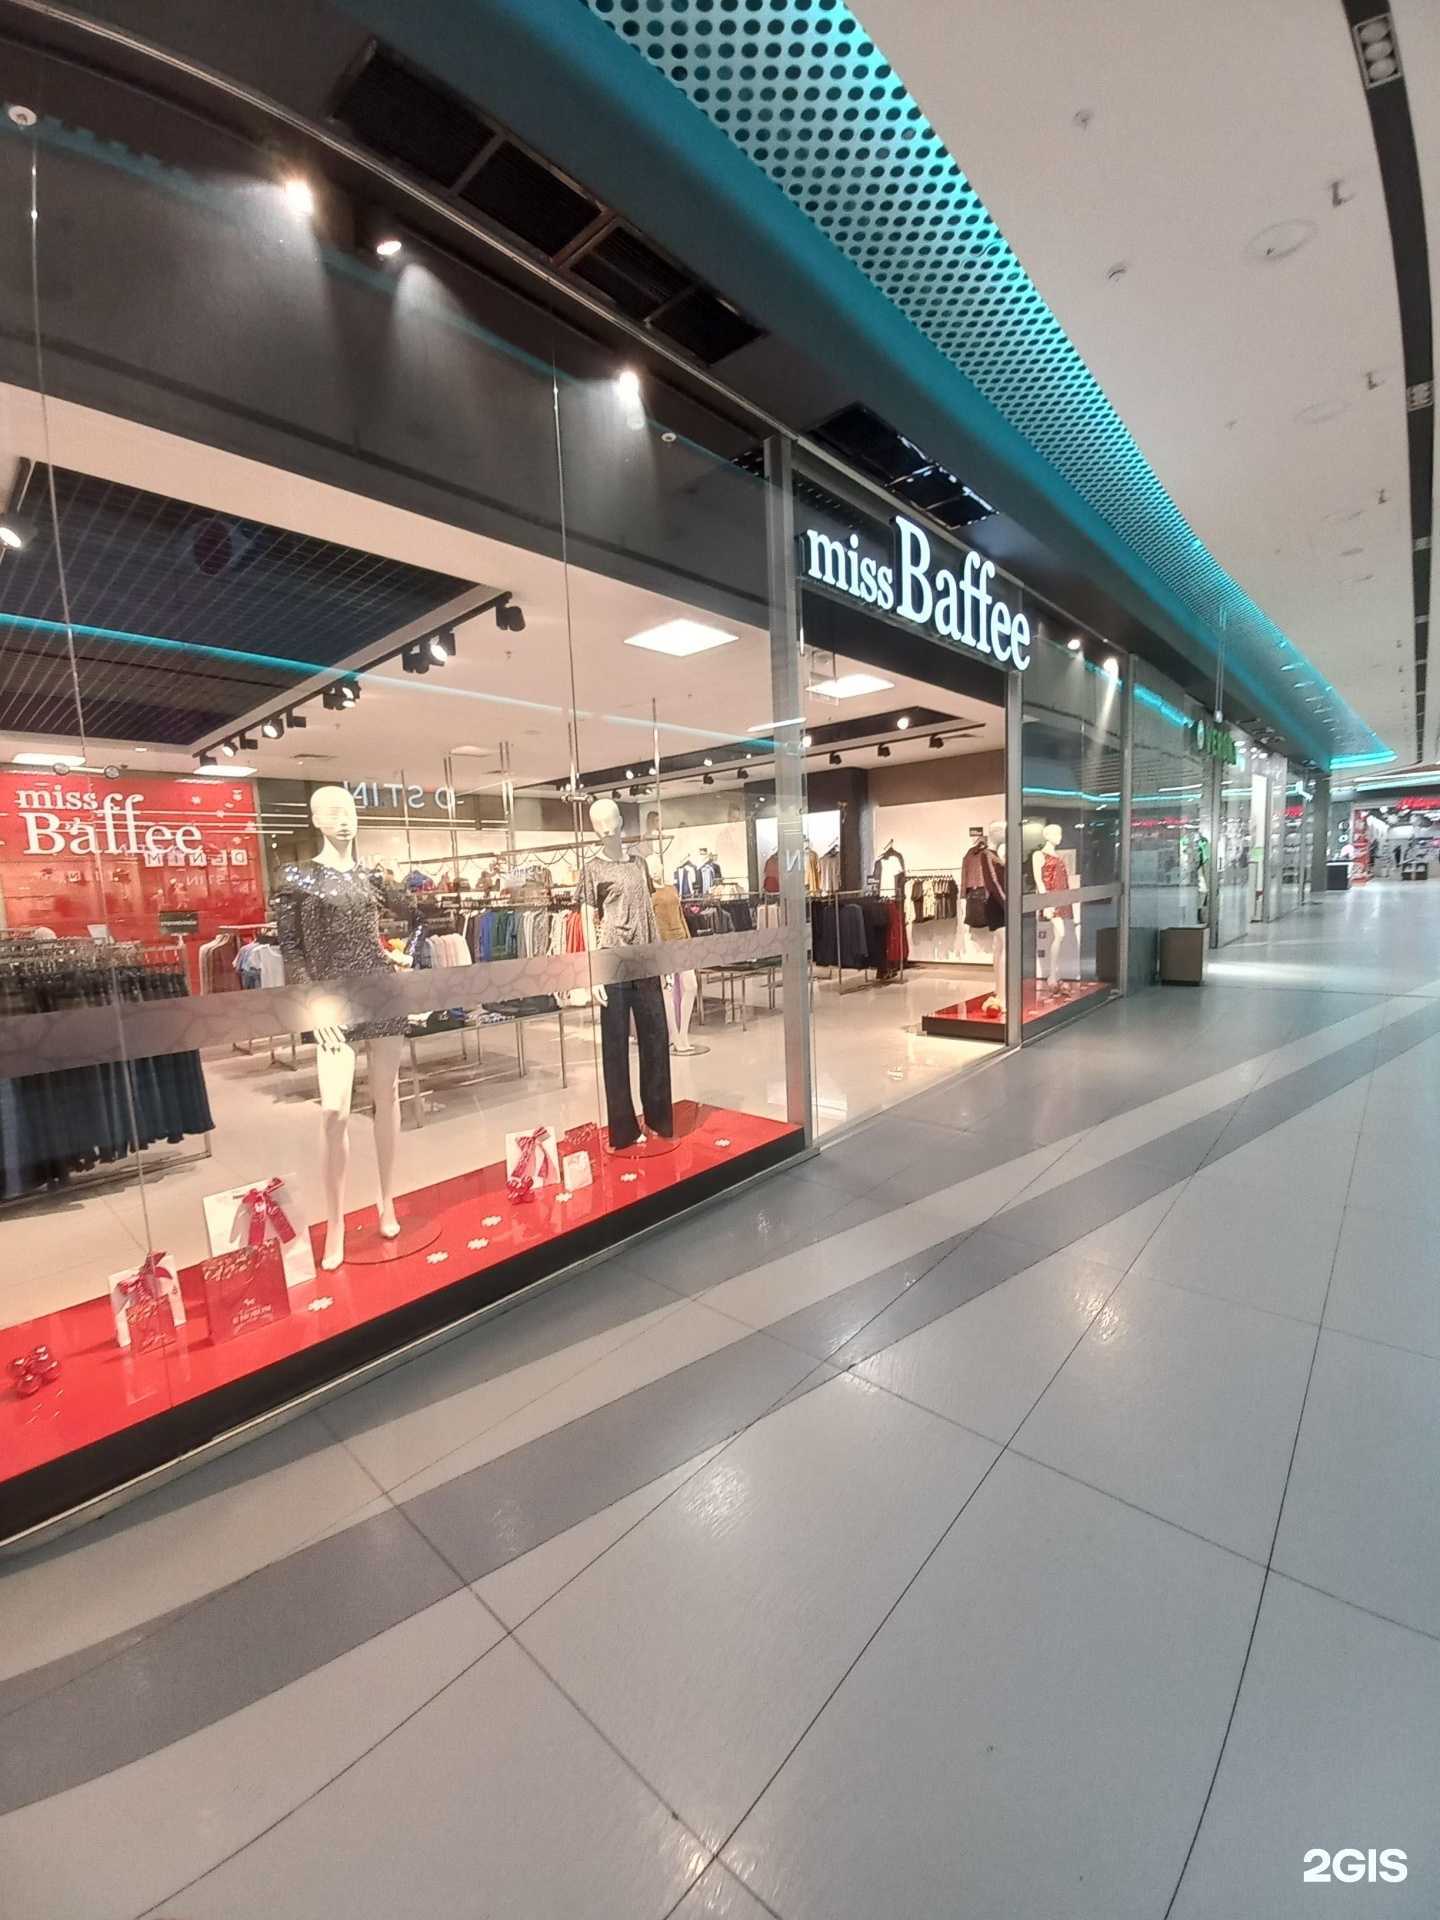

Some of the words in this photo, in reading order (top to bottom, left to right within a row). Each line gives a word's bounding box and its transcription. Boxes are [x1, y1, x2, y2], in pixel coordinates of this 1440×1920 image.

[806, 530, 895, 610] miss
[895, 516, 1031, 671] Baffee
[16, 785, 97, 811] miss
[21, 795, 202, 856] Baffee
